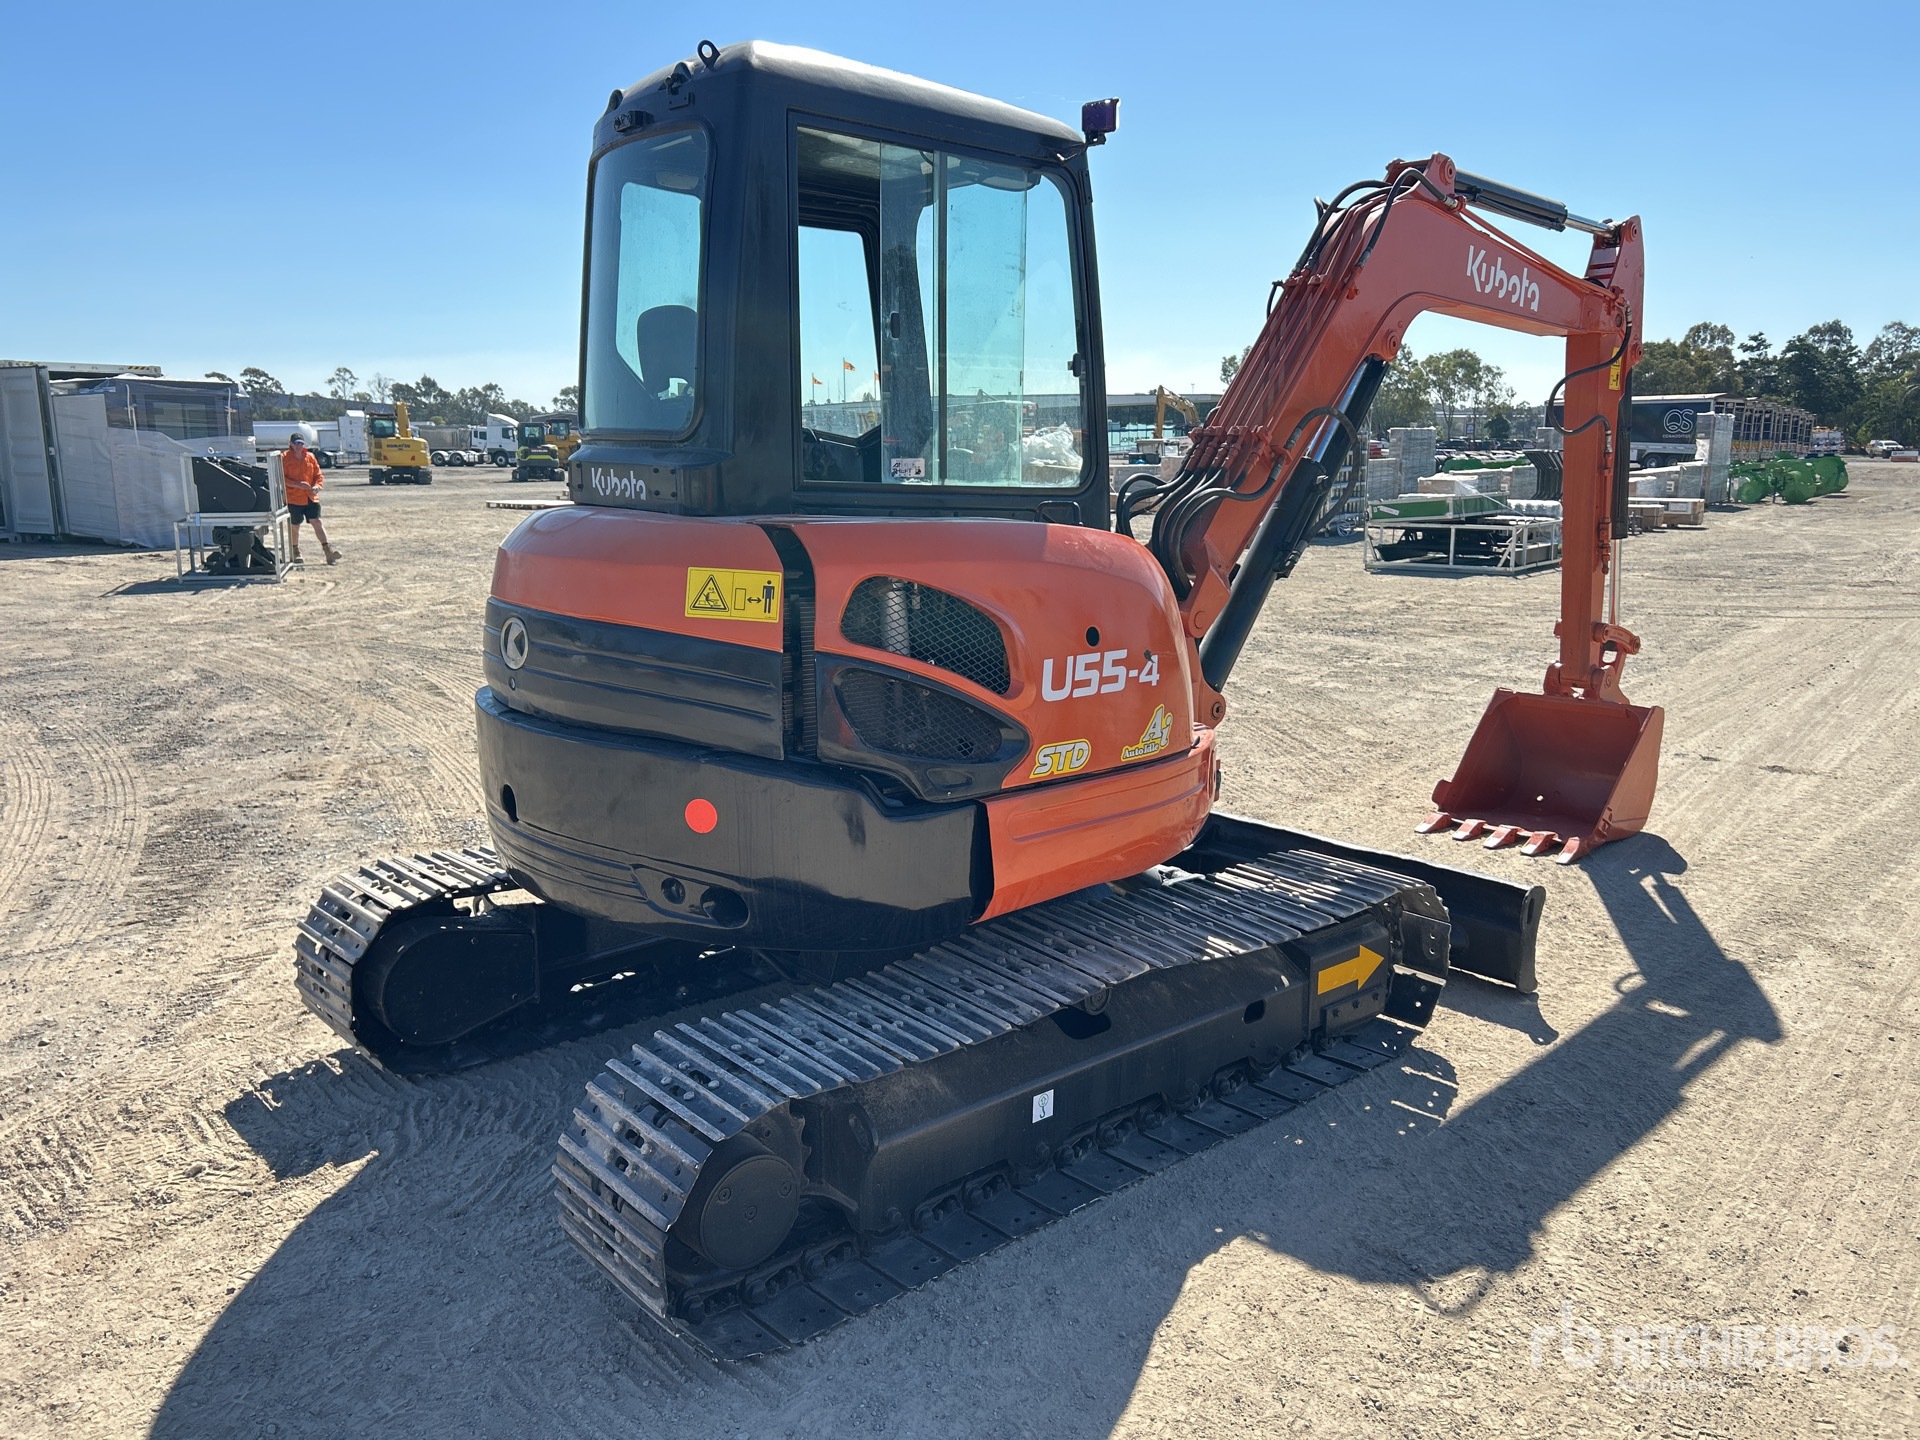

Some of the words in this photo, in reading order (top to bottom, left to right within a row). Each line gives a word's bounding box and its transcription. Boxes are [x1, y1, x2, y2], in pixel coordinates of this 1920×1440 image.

[1466, 244, 1540, 312] Kubota
[591, 467, 647, 501] Kubota
[1041, 649, 1160, 702] U55-4
[1033, 741, 1090, 775] STD
